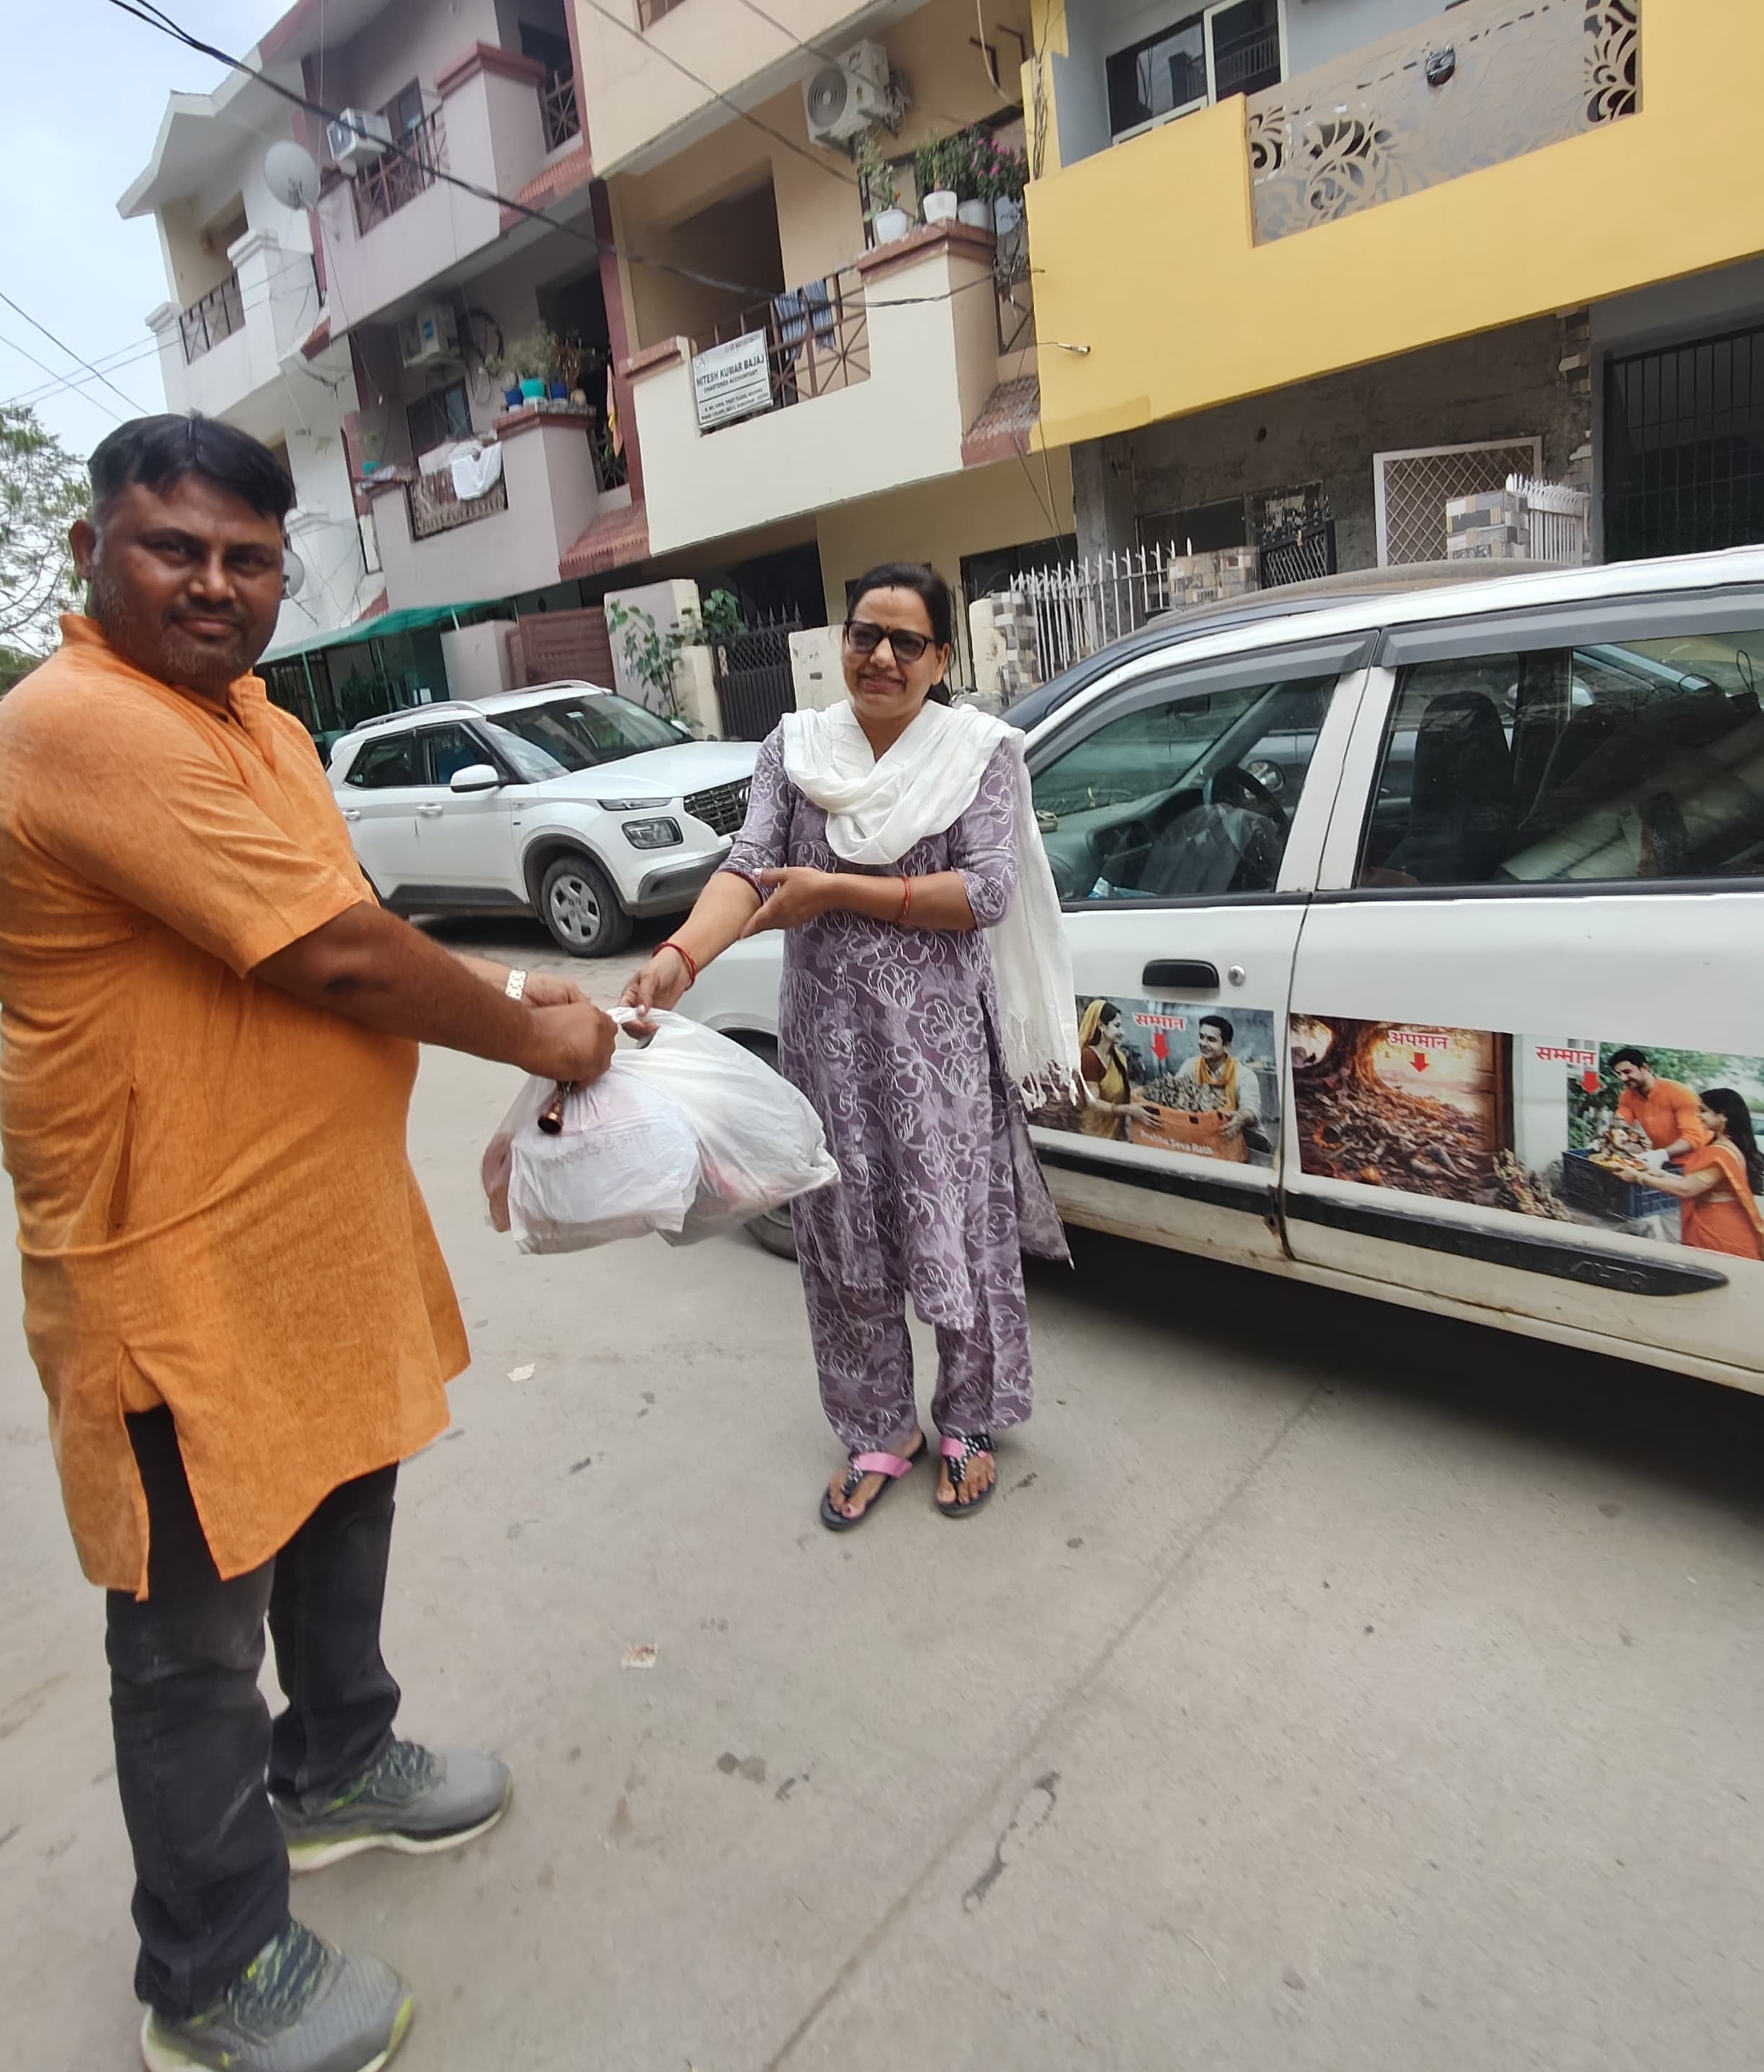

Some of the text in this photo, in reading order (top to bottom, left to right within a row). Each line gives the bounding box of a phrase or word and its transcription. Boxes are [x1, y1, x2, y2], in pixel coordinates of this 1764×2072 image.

[720, 362, 743, 379] KUMAR
[744, 354, 765, 371] BAJAJ
[1133, 1013, 1186, 1030] सम्मान
[1388, 1032, 1450, 1050] अपमान
[1536, 1047, 1597, 1065] सम्मान
[1170, 1138, 1190, 1151] Seva
